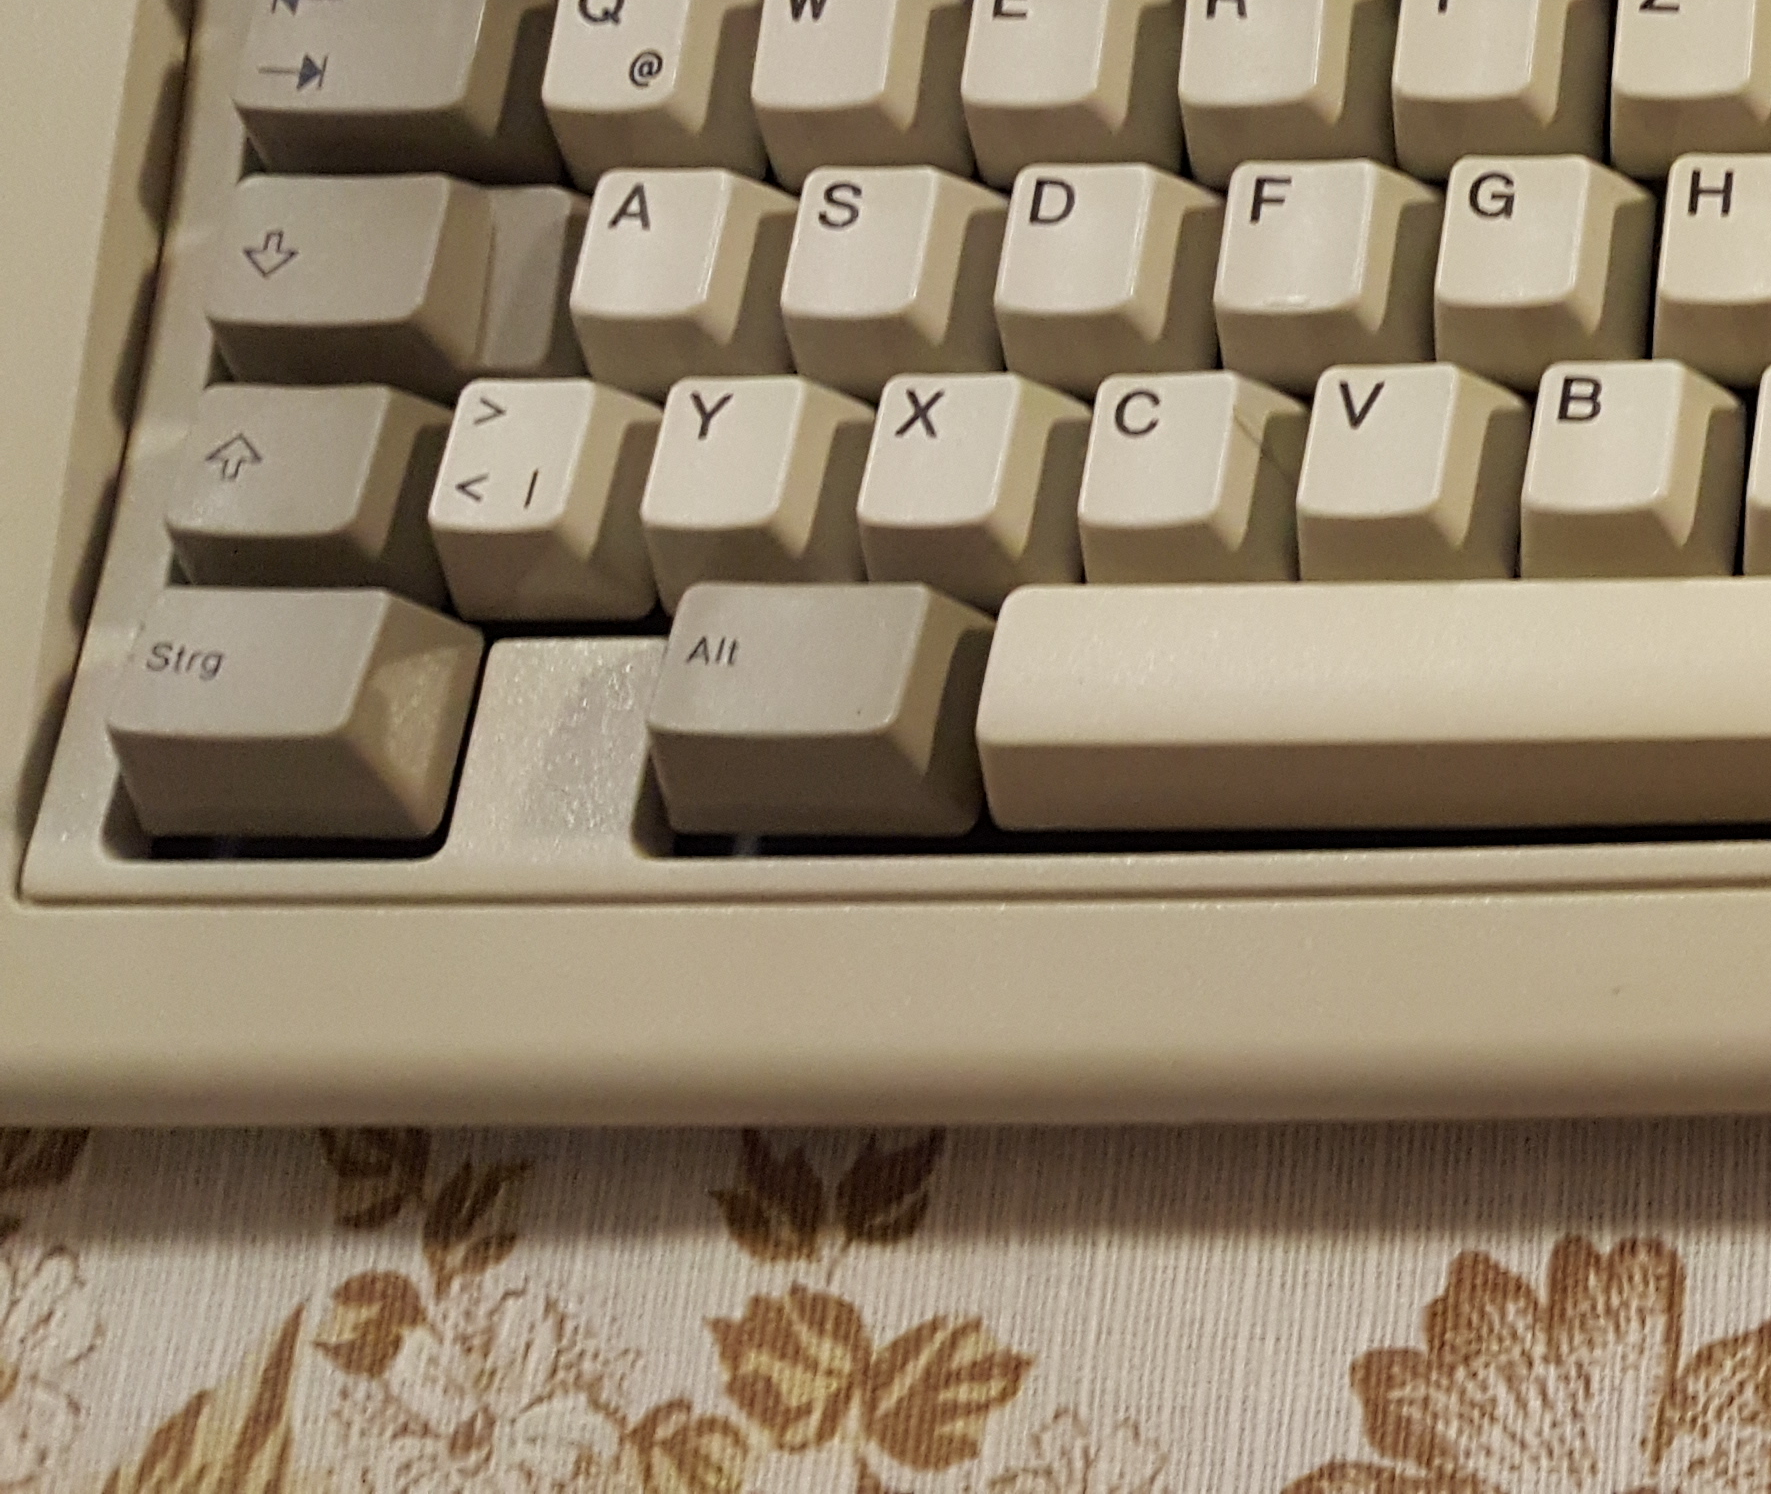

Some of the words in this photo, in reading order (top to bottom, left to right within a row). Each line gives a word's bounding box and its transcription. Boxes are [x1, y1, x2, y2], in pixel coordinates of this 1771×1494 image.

[628, 49, 664, 89] @
[608, 183, 651, 231] A
[817, 181, 863, 230] S
[1028, 177, 1076, 226] D
[1249, 176, 1292, 224] F
[1468, 171, 1515, 219] G
[1687, 168, 1734, 217] H
[690, 391, 733, 441] Y
[894, 388, 945, 438] X
[1114, 388, 1161, 438] C
[1338, 380, 1385, 430] V
[1557, 375, 1602, 423] B
[145, 641, 226, 681] Strg
[686, 635, 740, 670] Alt
